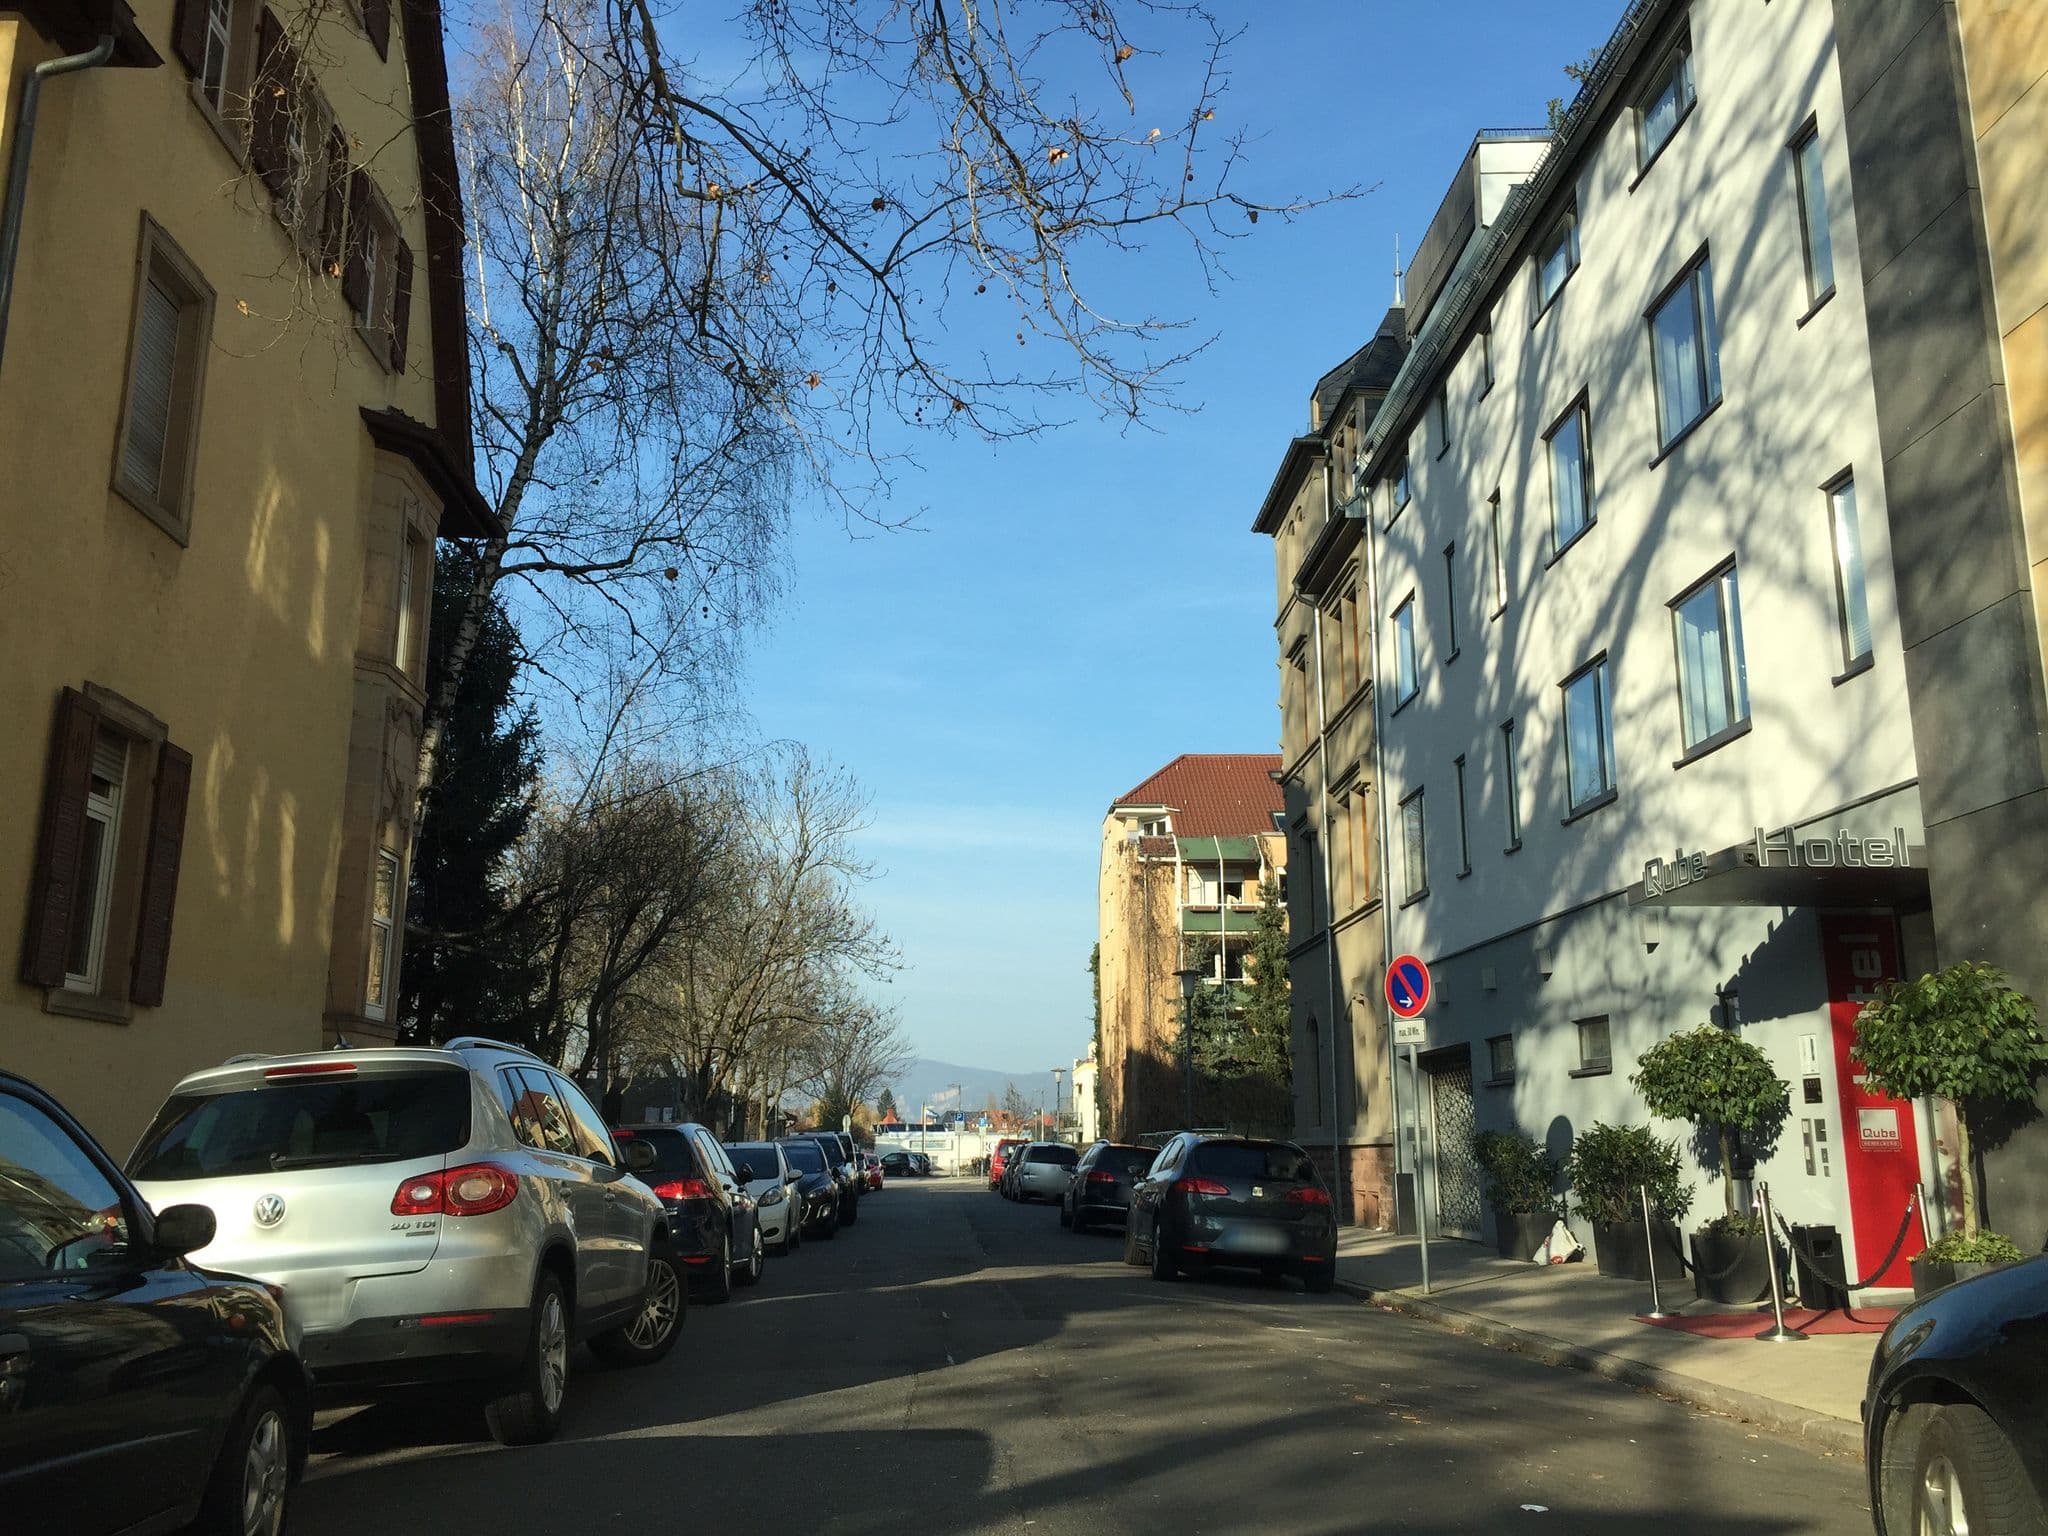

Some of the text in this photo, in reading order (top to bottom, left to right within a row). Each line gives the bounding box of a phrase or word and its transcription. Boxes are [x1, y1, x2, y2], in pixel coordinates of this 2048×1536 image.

[1642, 826, 1910, 898] Qube Hotel
[1862, 1128, 1897, 1138] Qube
[415, 1220, 436, 1229] TDI
